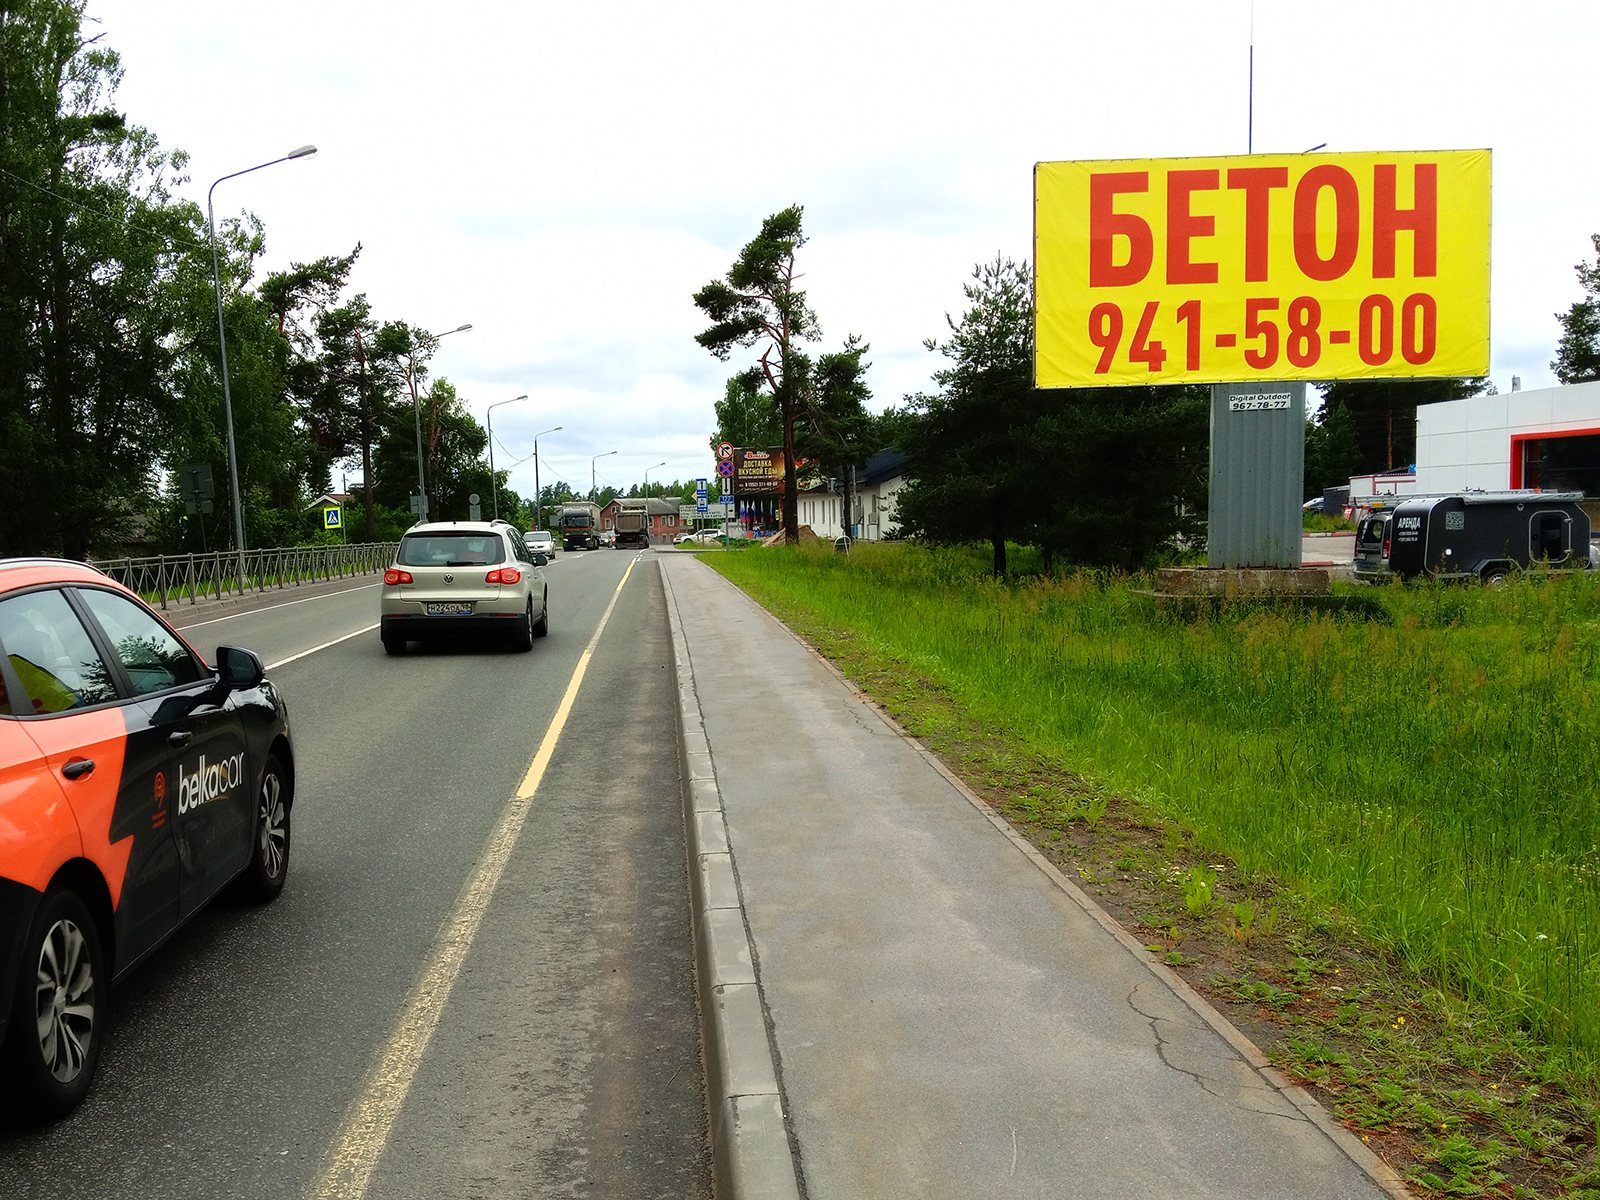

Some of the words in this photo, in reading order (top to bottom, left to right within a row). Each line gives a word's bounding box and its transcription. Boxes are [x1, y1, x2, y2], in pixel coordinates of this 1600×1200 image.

[1089, 163, 1438, 288] БЕТОН
[1088, 292, 1438, 375] 941-58-00
[1232, 401, 1287, 410] 967-78-77
[738, 467, 764, 475] ВКУСНОЙ
[764, 467, 778, 475] ЕДЫ
[743, 460, 772, 468] ДОСТАВКА
[1397, 516, 1421, 531] АРЕНДА
[177, 752, 244, 816] belkacar
